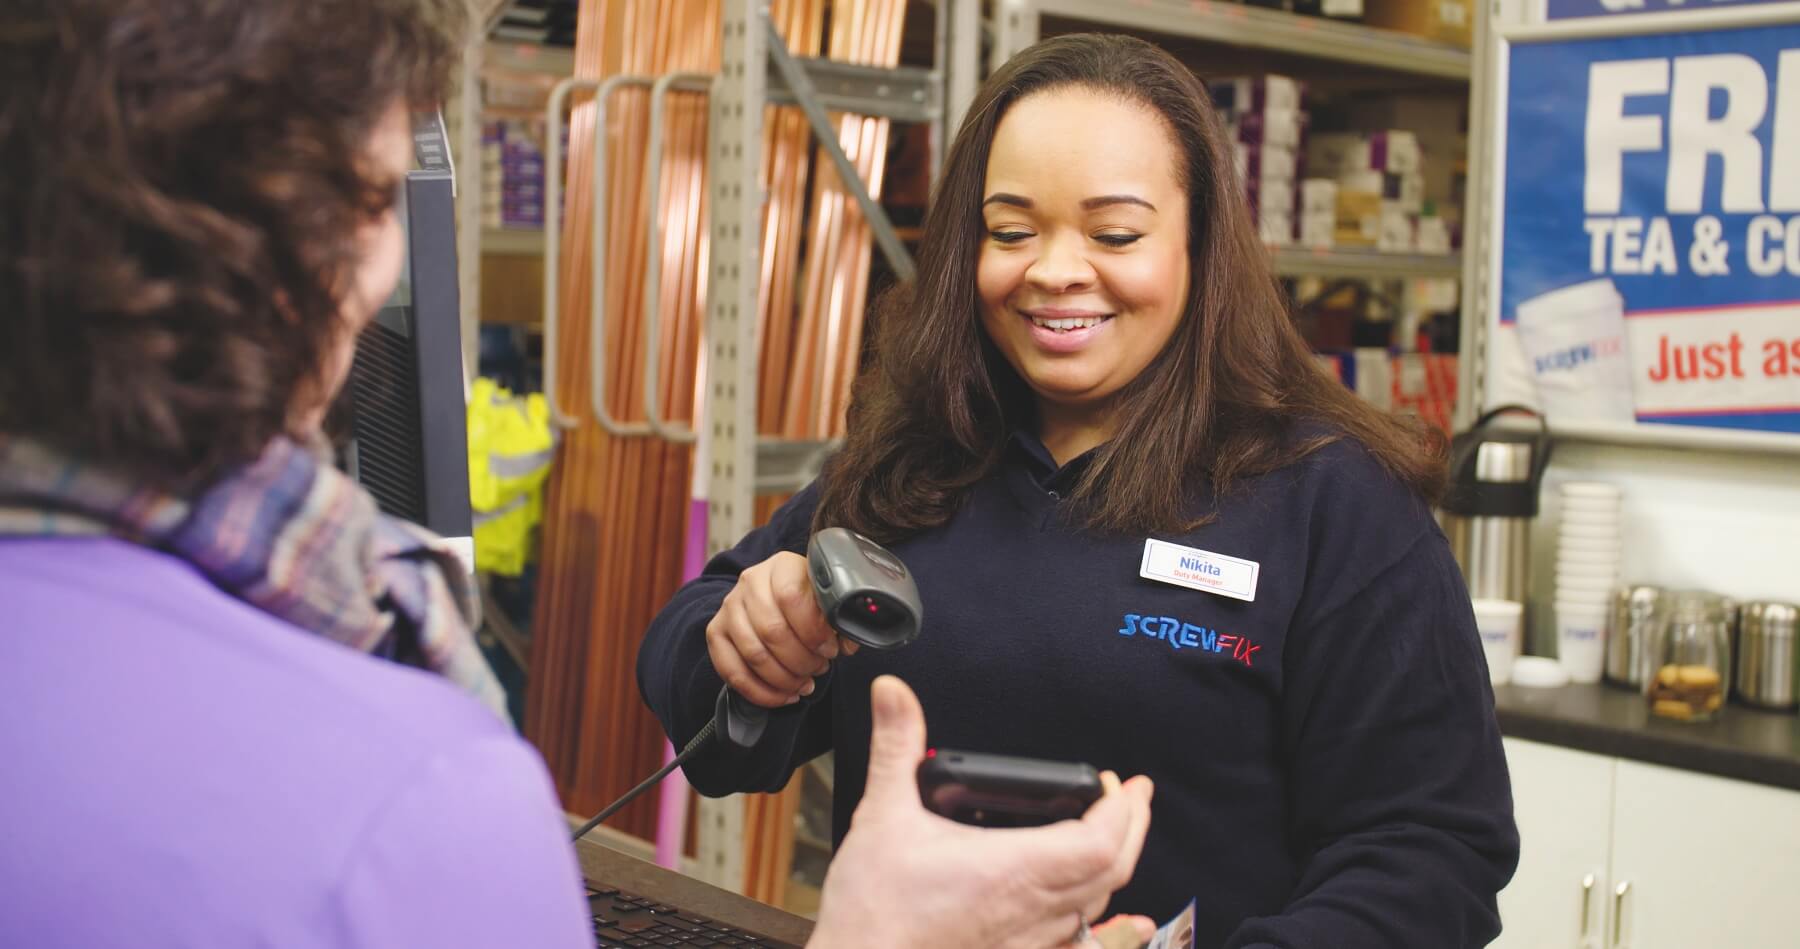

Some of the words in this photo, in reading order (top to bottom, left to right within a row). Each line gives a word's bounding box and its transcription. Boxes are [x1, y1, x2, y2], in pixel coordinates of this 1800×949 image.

[1584, 50, 1800, 214] FR
[1584, 216, 1678, 275] TEA
[1689, 215, 1730, 276] &
[1648, 331, 1744, 382] Just
[1174, 569, 1190, 579] Duty
[1191, 573, 1224, 586] Manager
[1180, 556, 1221, 576] Nikita
[1119, 613, 1260, 667] SCREWFIX
